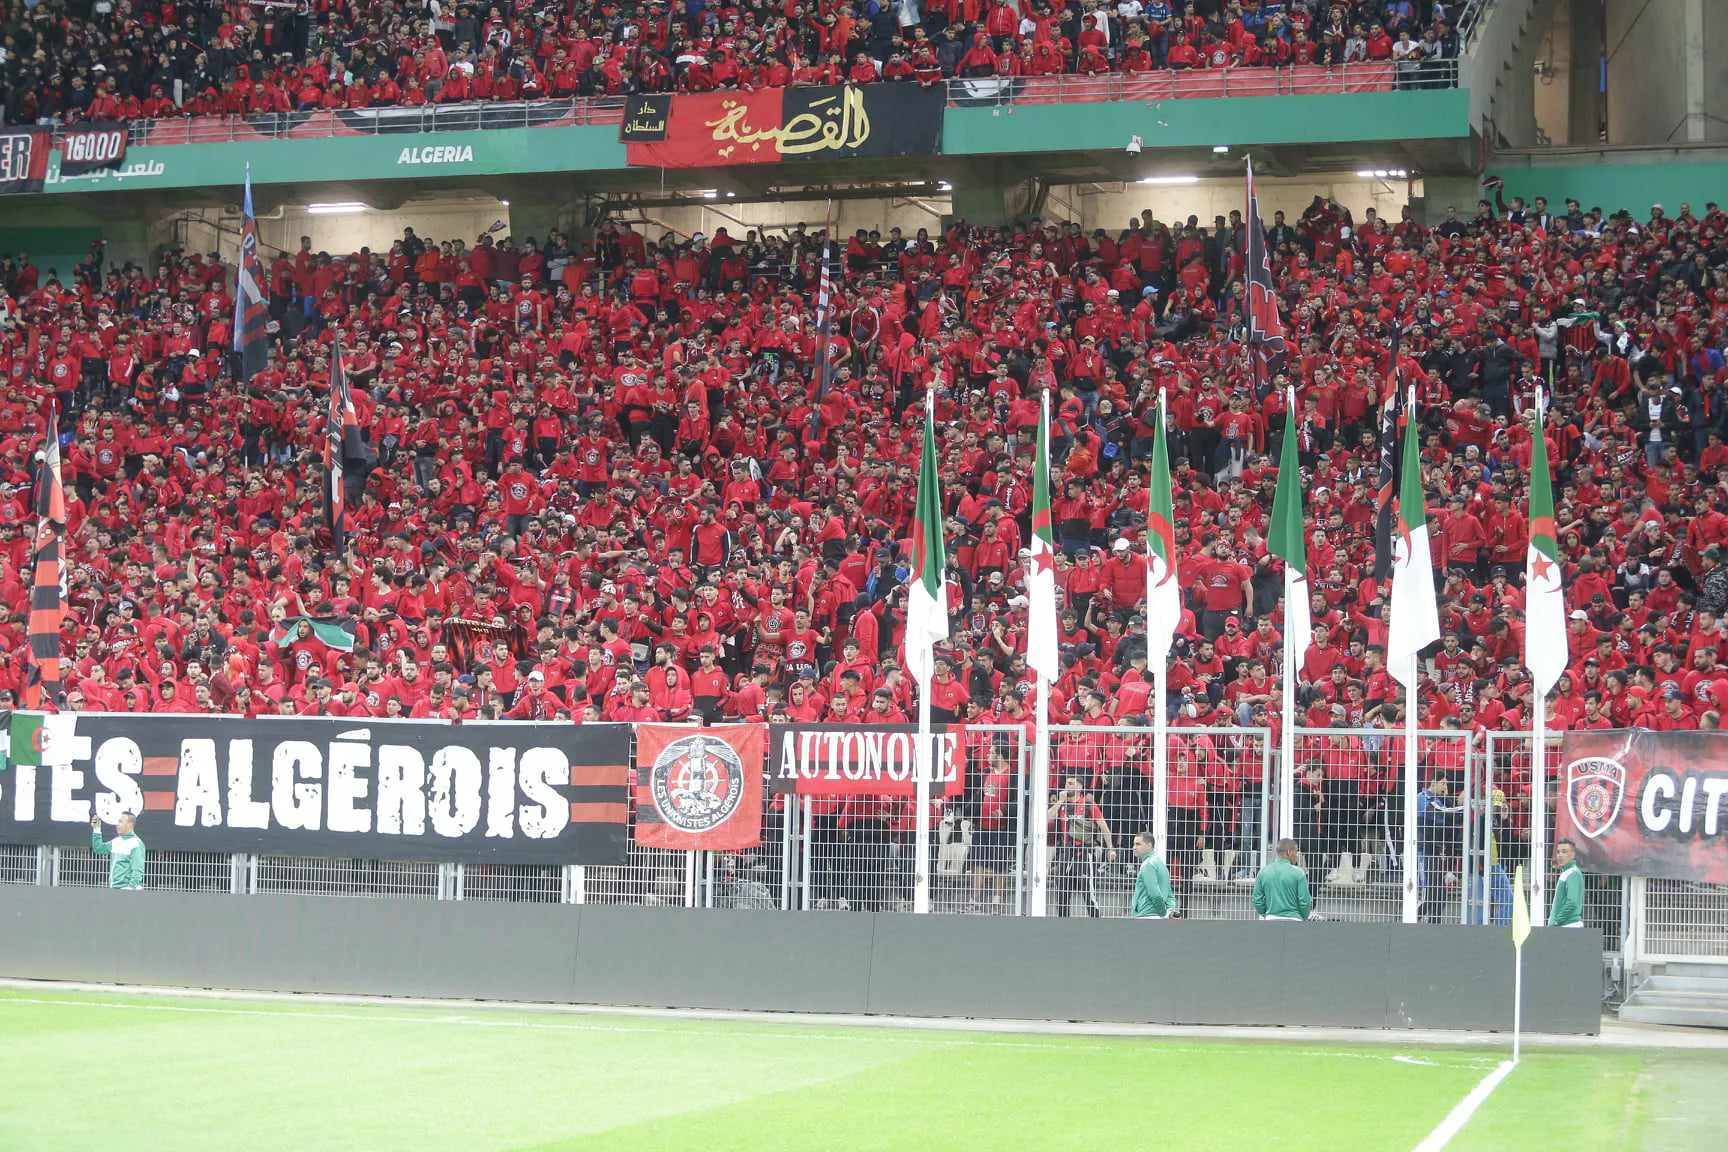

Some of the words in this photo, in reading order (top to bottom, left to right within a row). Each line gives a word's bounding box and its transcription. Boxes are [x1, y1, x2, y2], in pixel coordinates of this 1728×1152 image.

[636, 102, 656, 115] دار
[625, 120, 665, 134] السلطان
[65, 132, 121, 161] 16000
[397, 145, 473, 164] ALGERIA
[112, 160, 165, 181] ملعب
[174, 728, 570, 838] ALGÉROIS
[657, 779, 668, 799] LES
[1641, 773, 1728, 835] CIT
